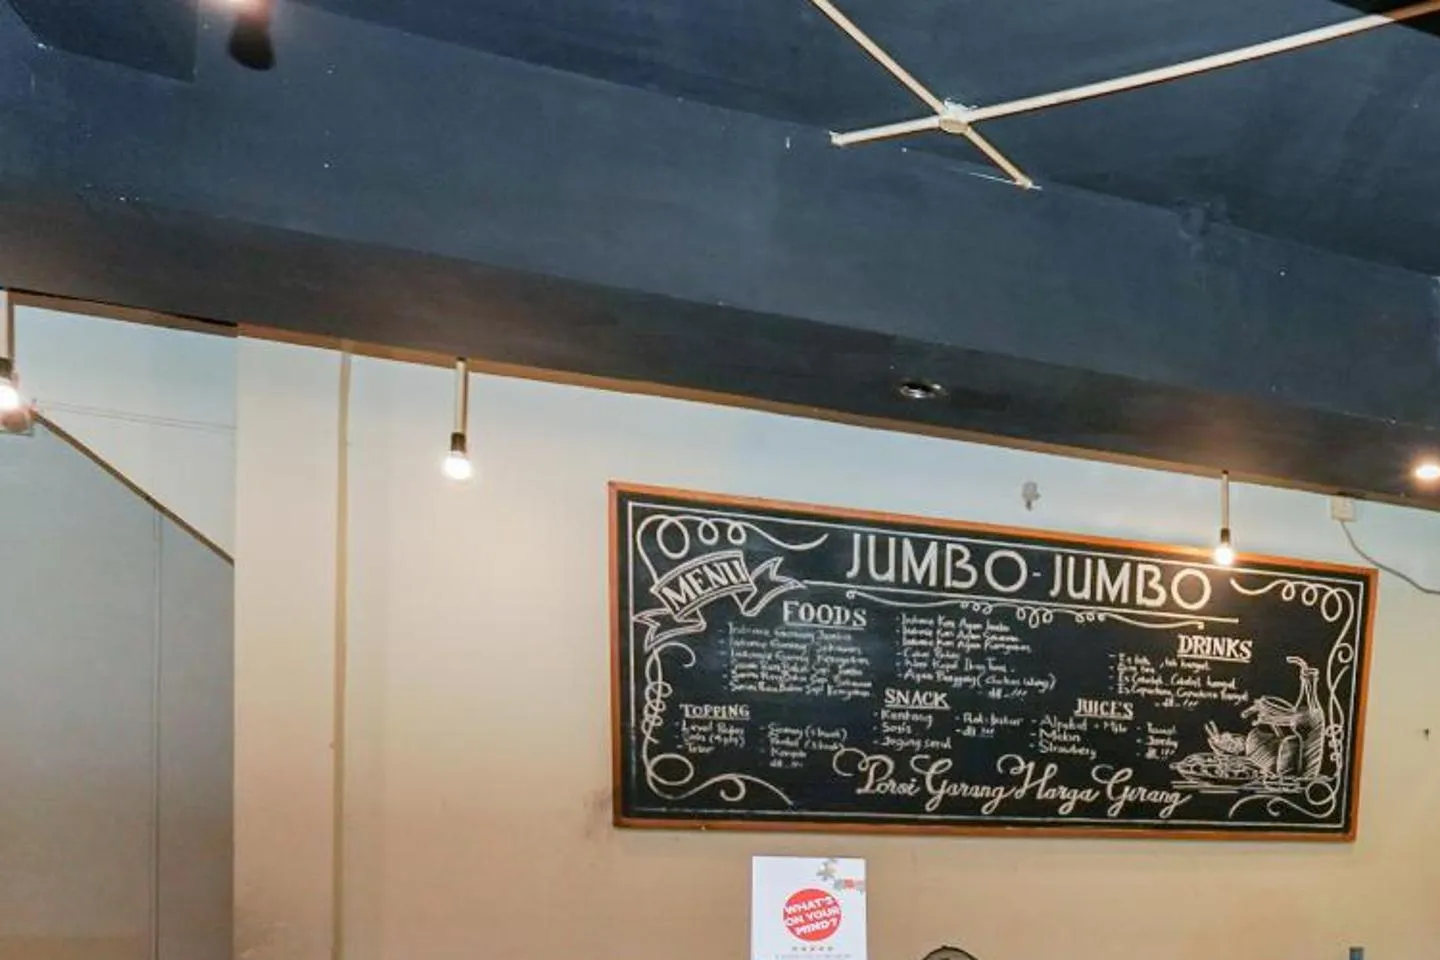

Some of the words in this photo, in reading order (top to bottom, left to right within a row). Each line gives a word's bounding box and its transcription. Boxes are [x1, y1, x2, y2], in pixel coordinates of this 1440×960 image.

[661, 560, 747, 611] MENU
[782, 600, 867, 627] FOODS
[1177, 633, 1252, 660] DRINKS
[884, 687, 950, 708] SNACK
[679, 703, 751, 720] TOPPING
[910, 754, 1016, 815] Garang
[997, 754, 1099, 816] Harga
[783, 914, 805, 927] ON
[805, 905, 841, 922] YOUR
[787, 896, 834, 915] WHAT'S
[796, 917, 838, 936] MIND?
